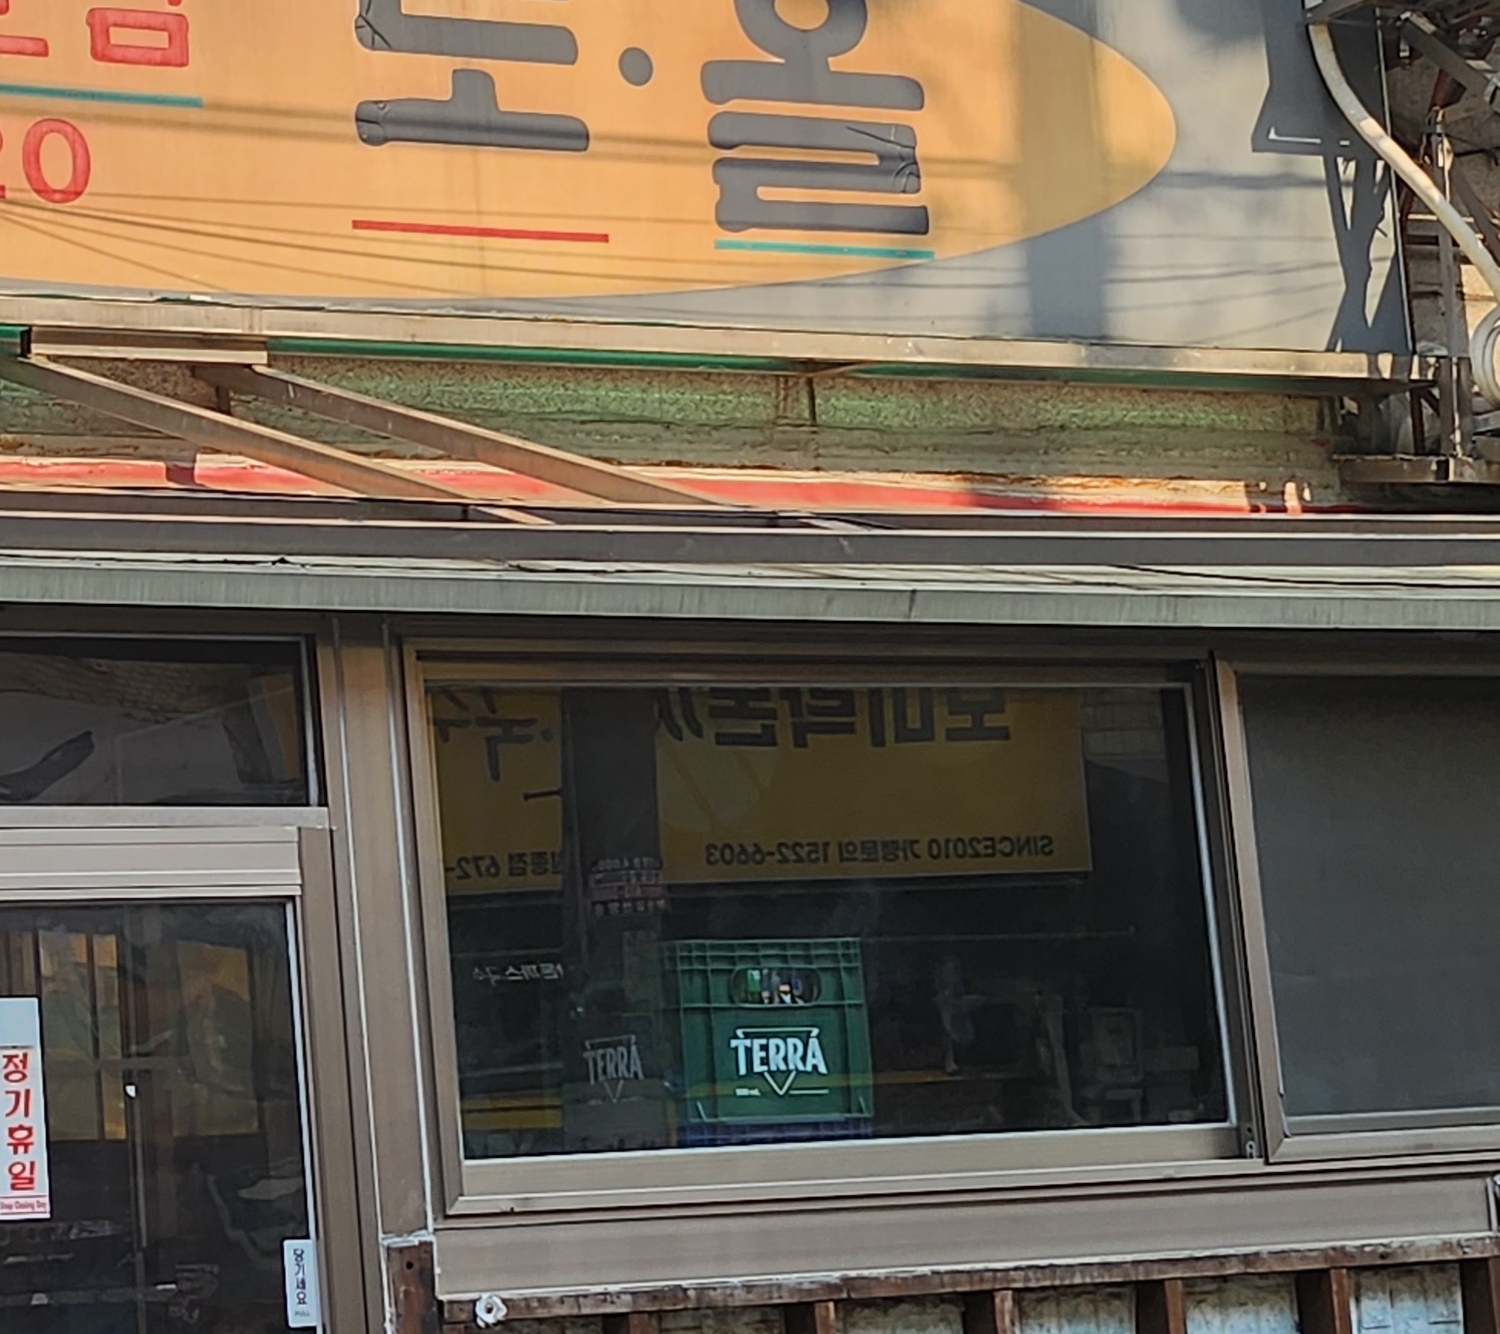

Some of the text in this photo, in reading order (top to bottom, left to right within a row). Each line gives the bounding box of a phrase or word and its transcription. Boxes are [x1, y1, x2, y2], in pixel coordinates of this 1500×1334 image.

[583, 1042, 645, 1086] TERRA
[730, 1035, 829, 1076] TERRA
[2, 1051, 36, 1191] 정기휴일
[293, 1248, 307, 1306] 당기세요
